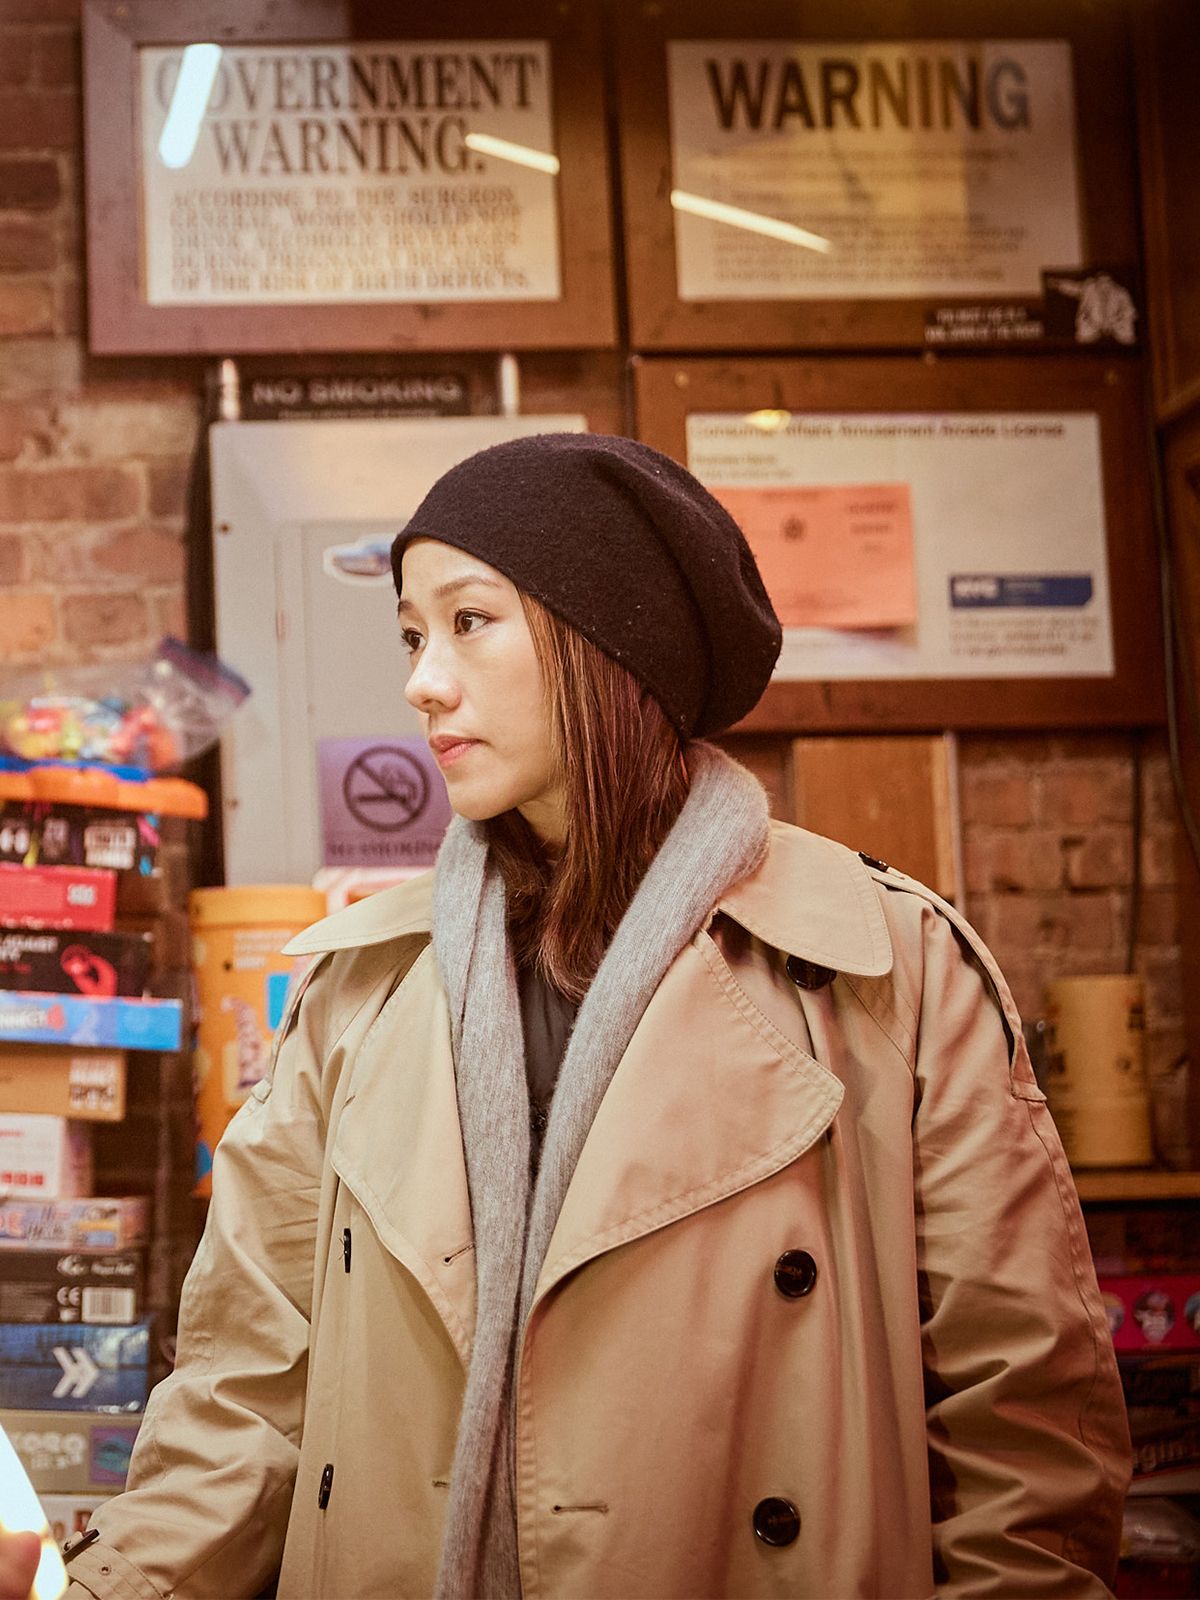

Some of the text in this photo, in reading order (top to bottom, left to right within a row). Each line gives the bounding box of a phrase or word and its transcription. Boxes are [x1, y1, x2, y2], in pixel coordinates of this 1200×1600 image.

[707, 57, 1031, 132] WARNING
[211, 115, 485, 174] WARNING.
[308, 376, 464, 404] SMOKING
